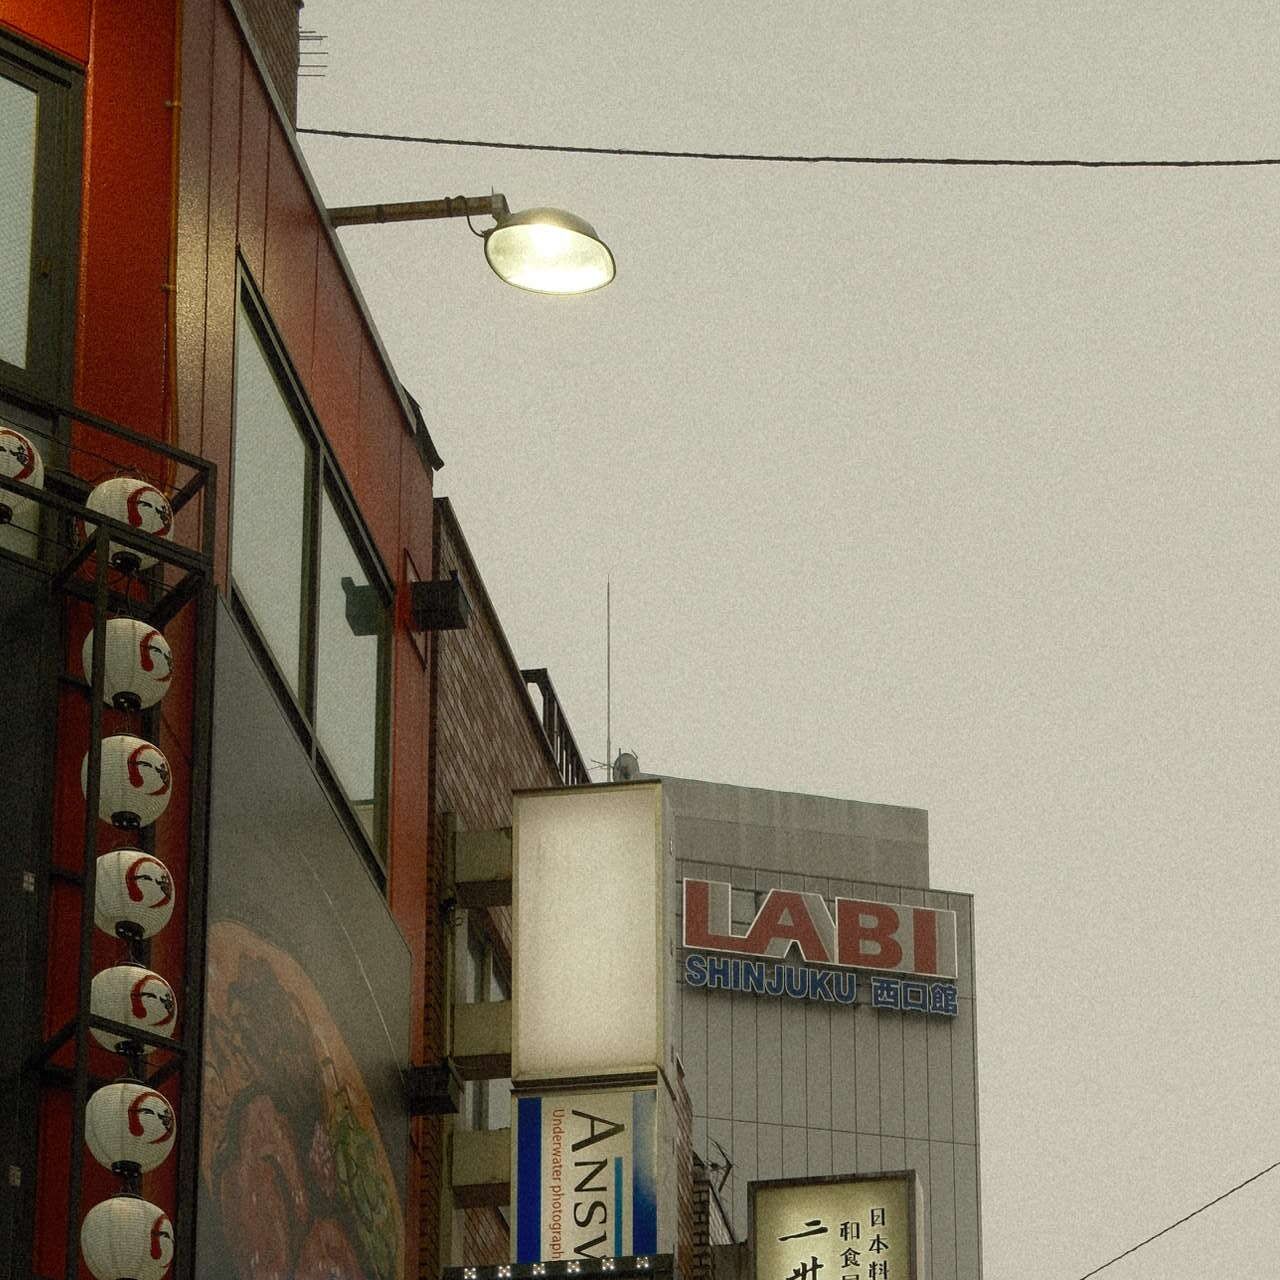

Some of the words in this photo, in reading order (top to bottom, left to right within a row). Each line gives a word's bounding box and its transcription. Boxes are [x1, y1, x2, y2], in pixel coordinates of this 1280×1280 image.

[683, 877, 957, 979] LABI
[685, 954, 857, 1005] SHINJUKU
[871, 976, 957, 1016] 西口館
[552, 1109, 564, 1181] Underwater
